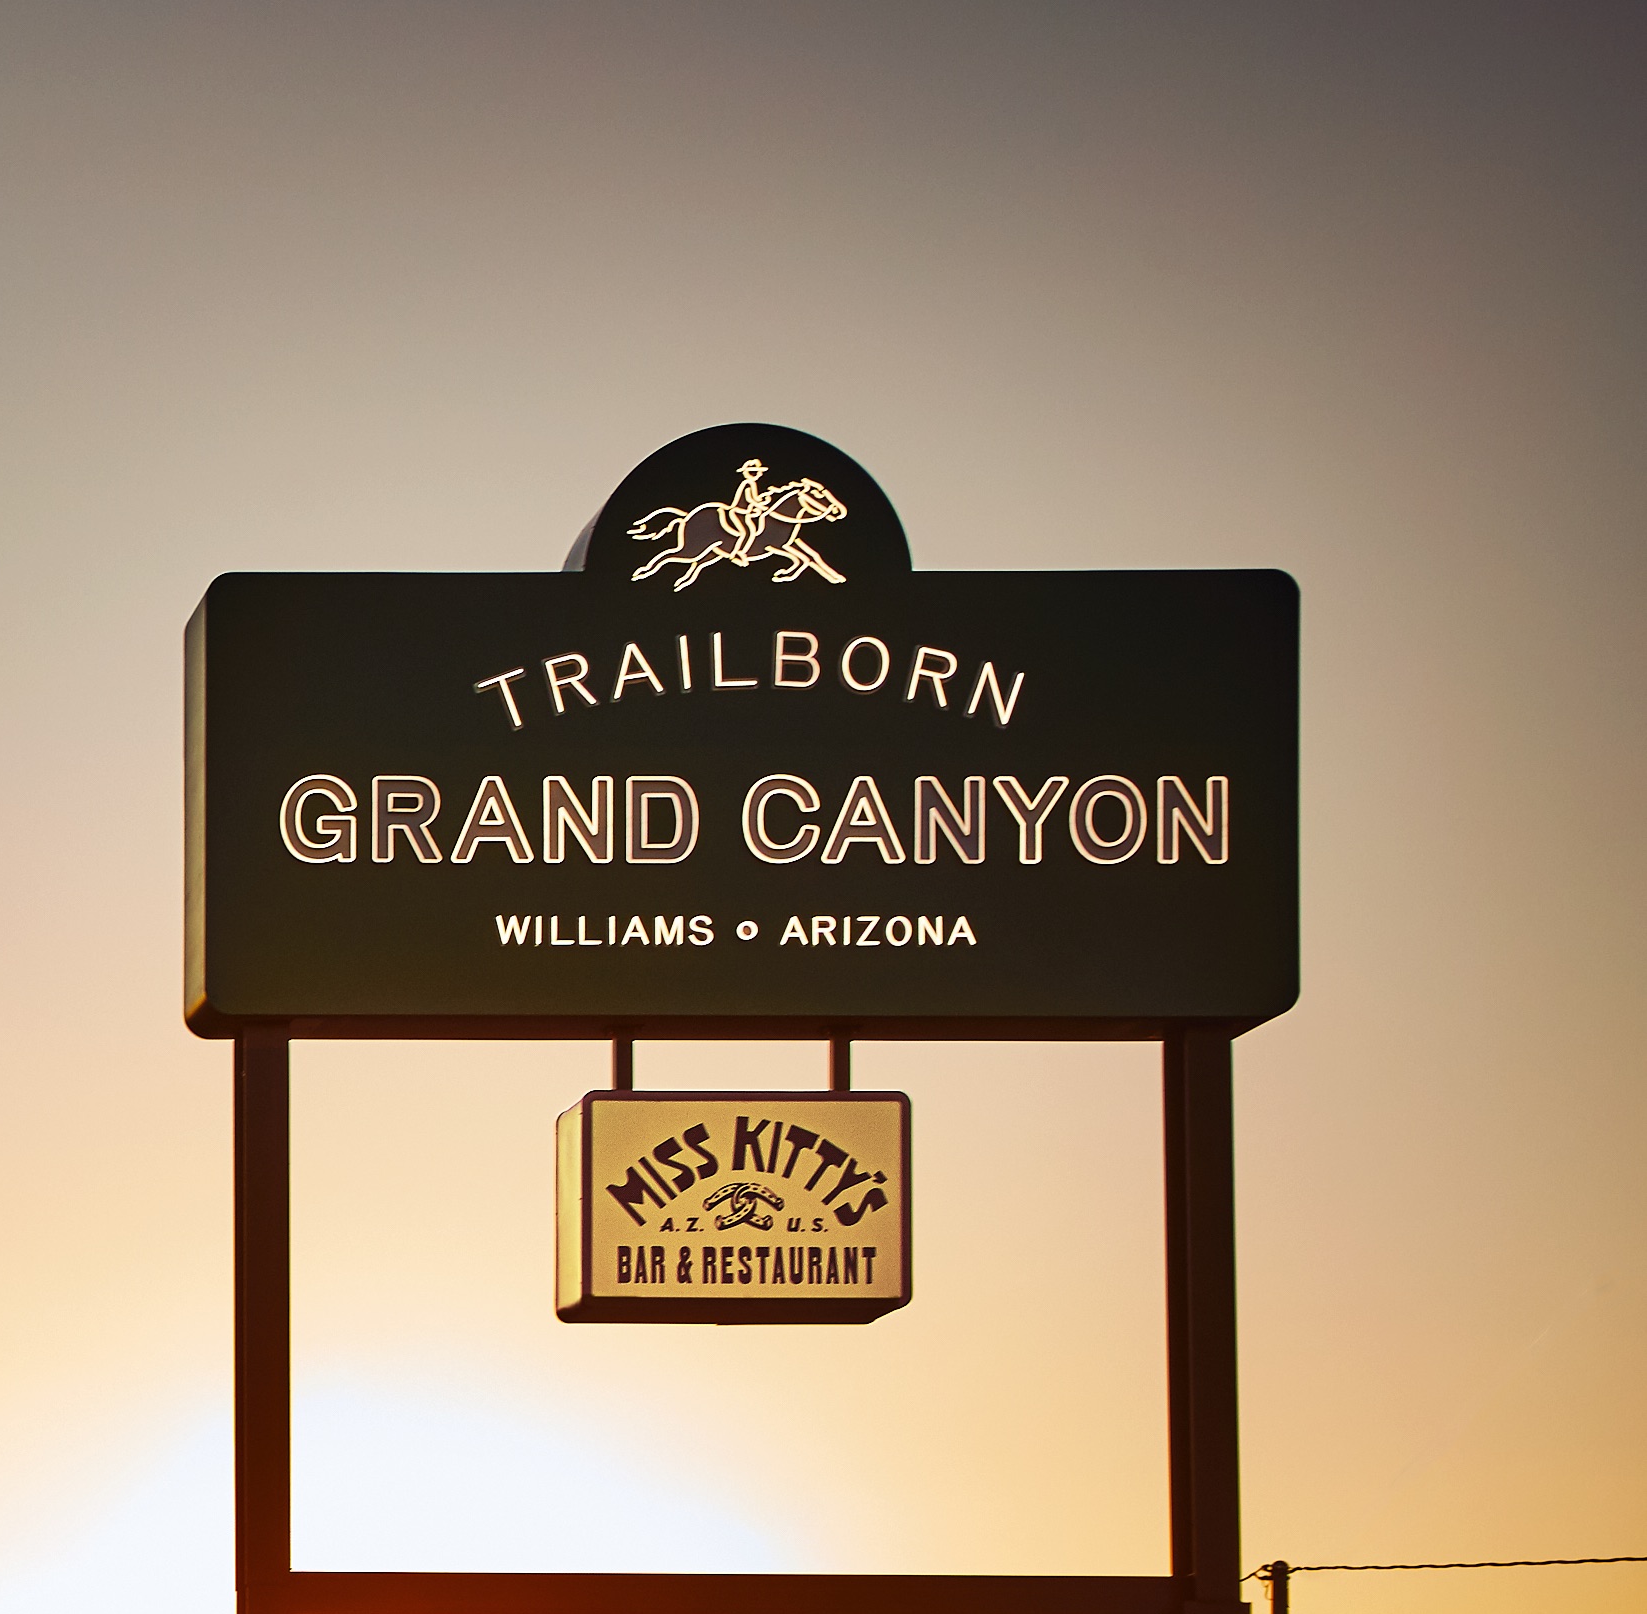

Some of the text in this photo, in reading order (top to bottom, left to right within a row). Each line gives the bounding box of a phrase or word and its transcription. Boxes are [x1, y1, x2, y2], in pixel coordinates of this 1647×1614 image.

[476, 630, 1025, 728] TRAILBORN
[280, 773, 1229, 865] GRAND CANYON
[495, 914, 977, 947] WILLIAMS ARIZONA
[607, 1115, 890, 1227] MISS KITTY'S
[617, 1245, 877, 1285] BAR & RESTAURANT
